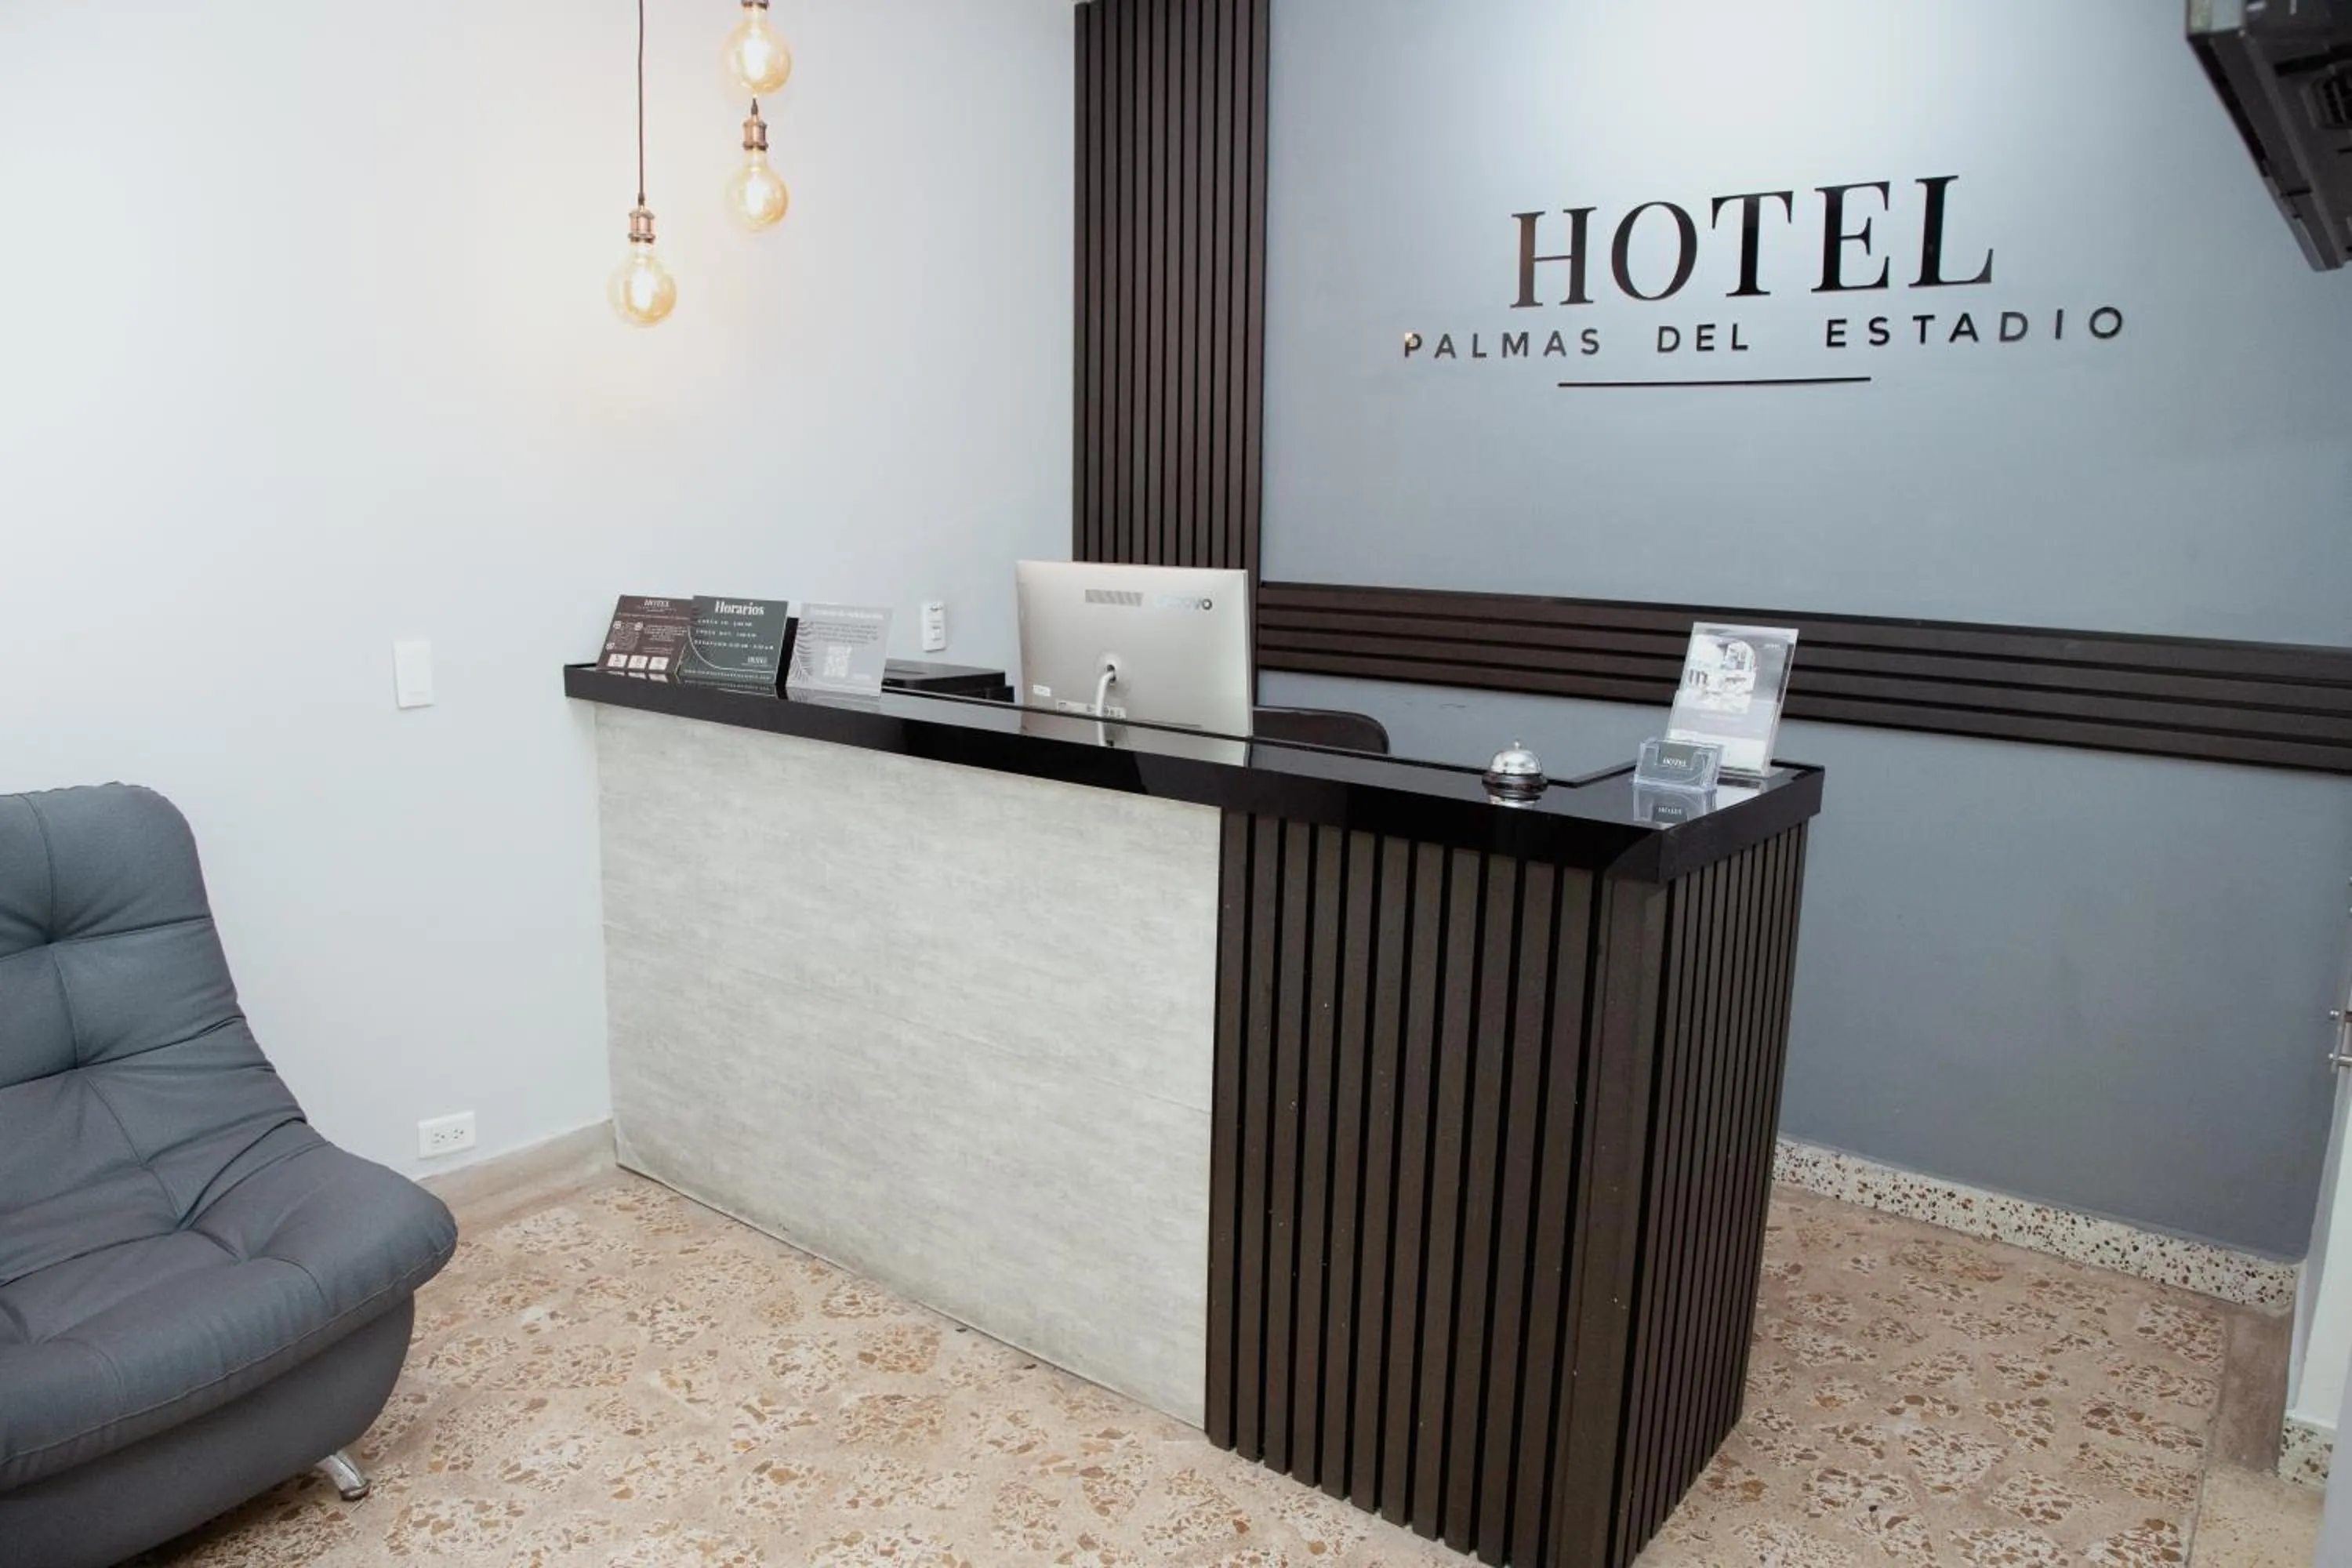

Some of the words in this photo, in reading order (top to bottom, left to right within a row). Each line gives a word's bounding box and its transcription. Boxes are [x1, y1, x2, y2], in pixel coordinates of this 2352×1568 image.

[1509, 174, 1995, 310] HOTEL
[1404, 328, 1600, 360] PALMAS
[1657, 322, 1749, 354] DEL
[1826, 303, 2125, 349] ESTADIO
[715, 601, 764, 615] Horarios
